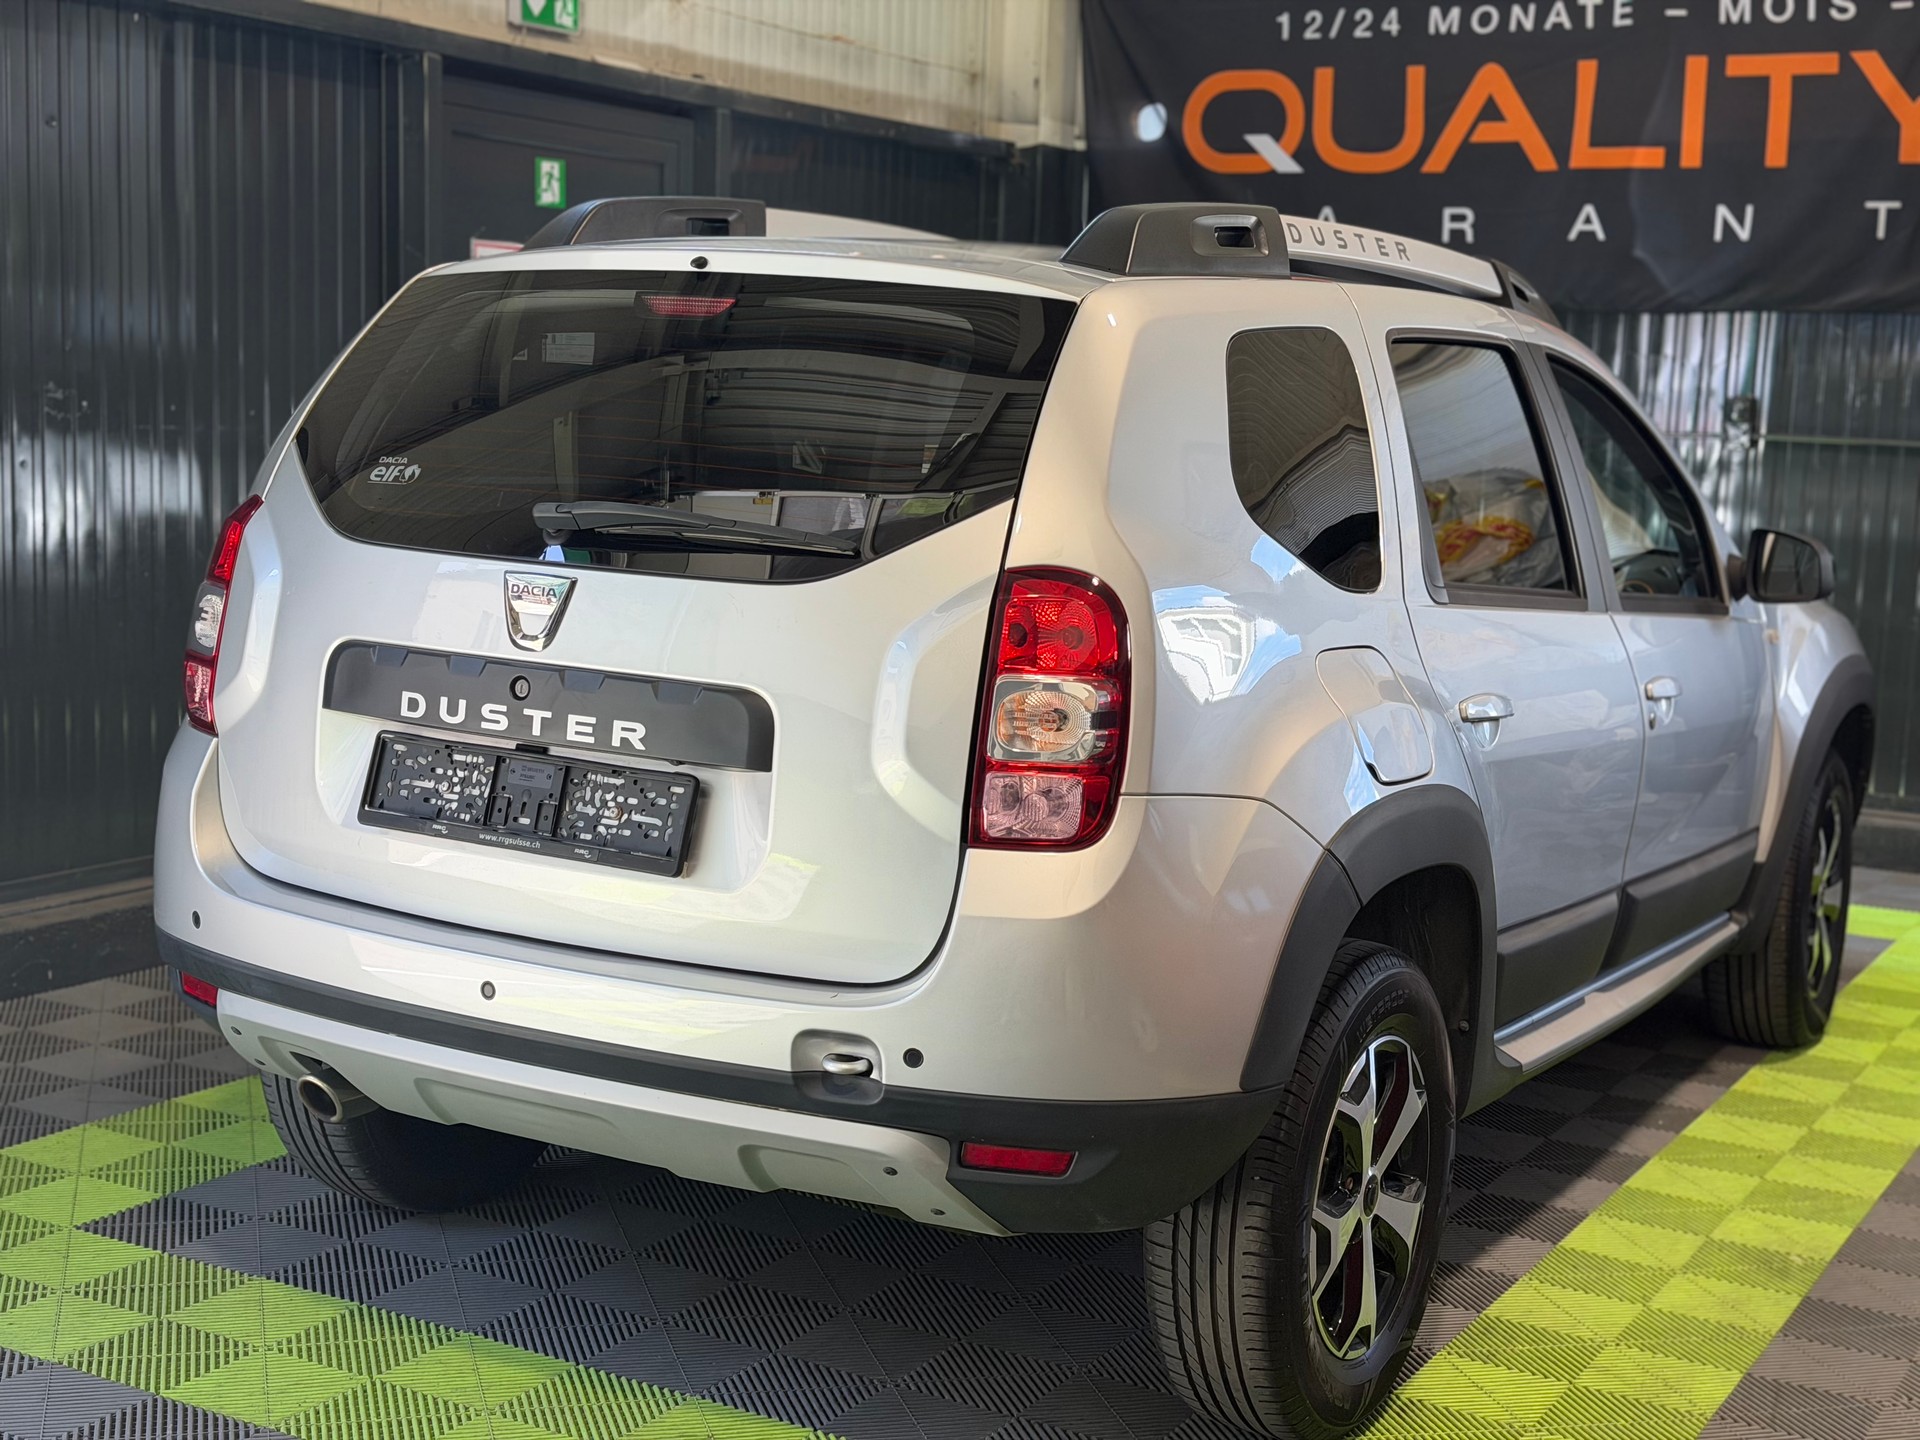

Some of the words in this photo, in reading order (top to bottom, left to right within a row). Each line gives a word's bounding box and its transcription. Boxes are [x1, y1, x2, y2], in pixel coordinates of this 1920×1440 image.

[1275, 6, 1402, 42] 12/24
[1427, 0, 1634, 36] MONATE
[1717, 0, 1858, 25] MOIS
[1286, 223, 1410, 261] DUSTER
[378, 456, 408, 464] DACIA
[369, 465, 405, 482] elf
[511, 584, 557, 598] DACIA
[400, 690, 646, 750] DUSTER
[479, 832, 541, 849] www.rrgsuisse.ch
